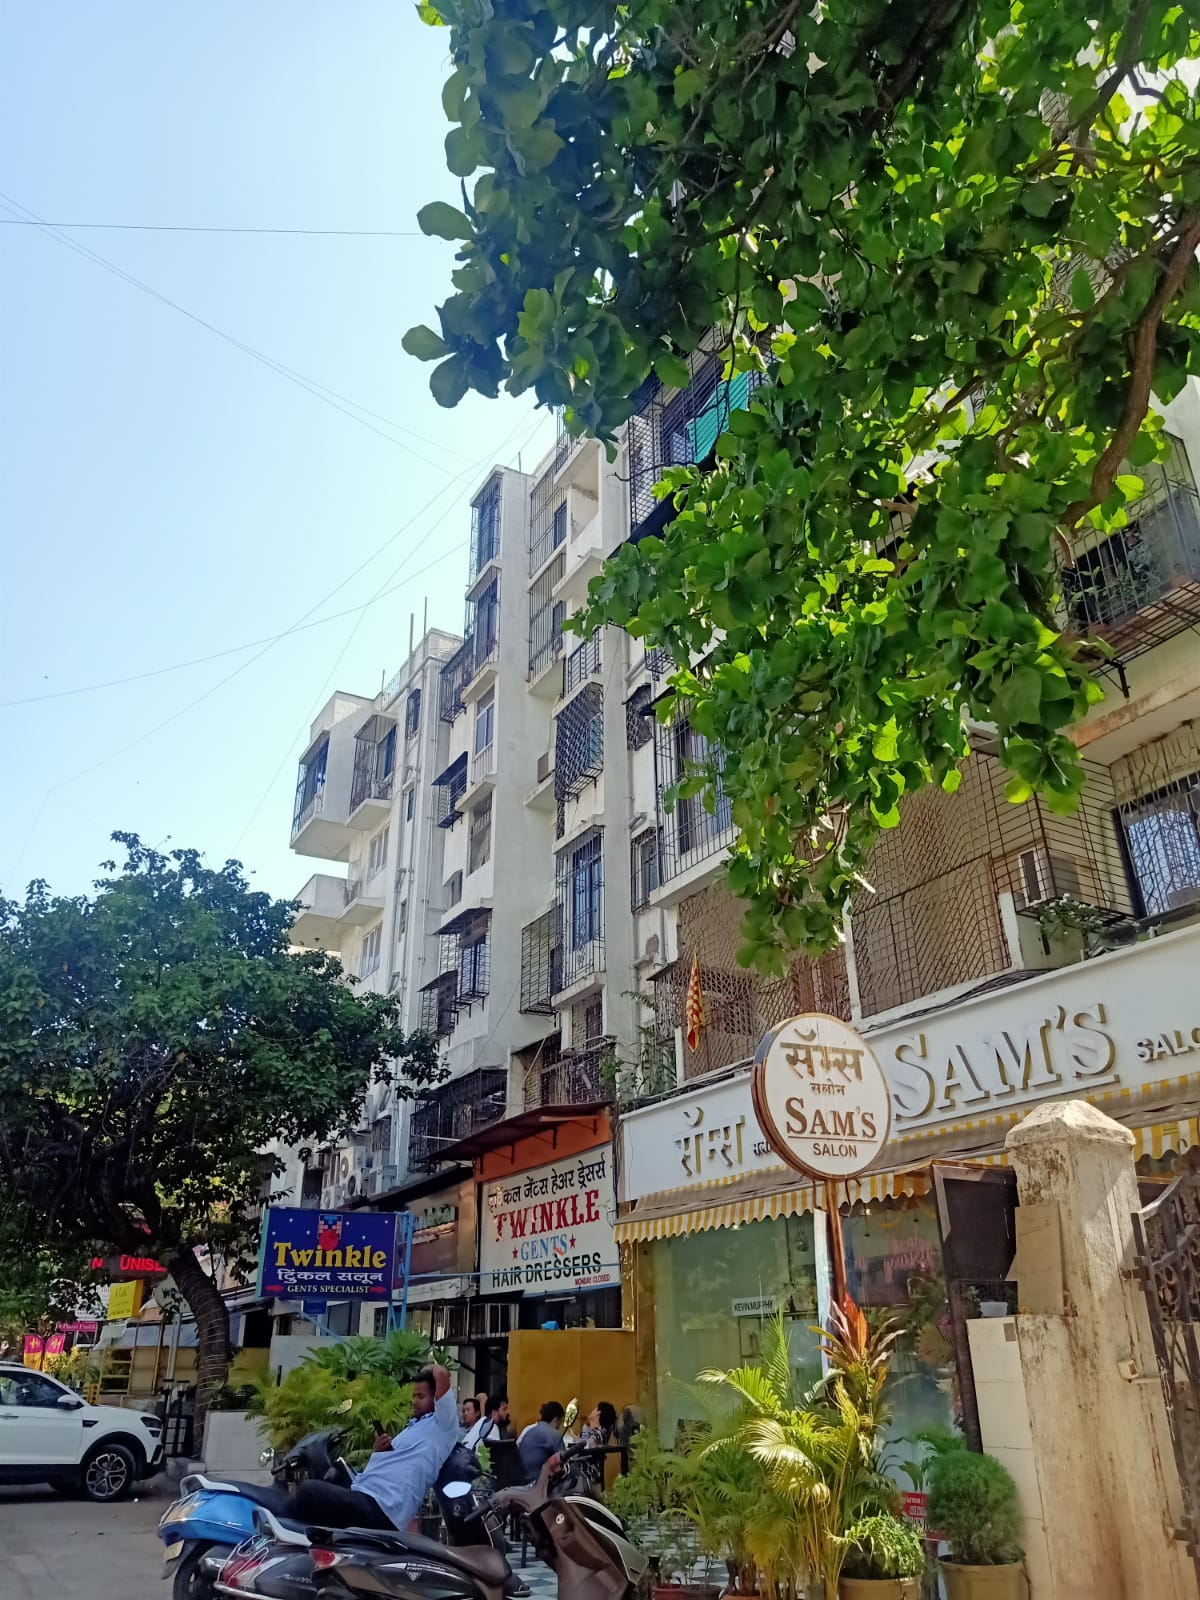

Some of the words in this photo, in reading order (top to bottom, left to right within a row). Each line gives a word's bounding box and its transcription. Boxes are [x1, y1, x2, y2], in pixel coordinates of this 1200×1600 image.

[884, 1001, 1118, 1119] SAM'S
[784, 1096, 877, 1139] SAM'S
[812, 1142, 858, 1158] SALON
[493, 1189, 600, 1243] TWINKLE
[273, 1241, 388, 1269] Twinkle
[520, 1233, 568, 1262] GENTS
[337, 1270, 384, 1285] सलून
[492, 1263, 522, 1289] HAIR
[525, 1251, 602, 1284] DRESSERS
[592, 1273, 611, 1284] CLOSED
[287, 1284, 318, 1293] GENTS
[319, 1284, 370, 1294] SPECIALIST
